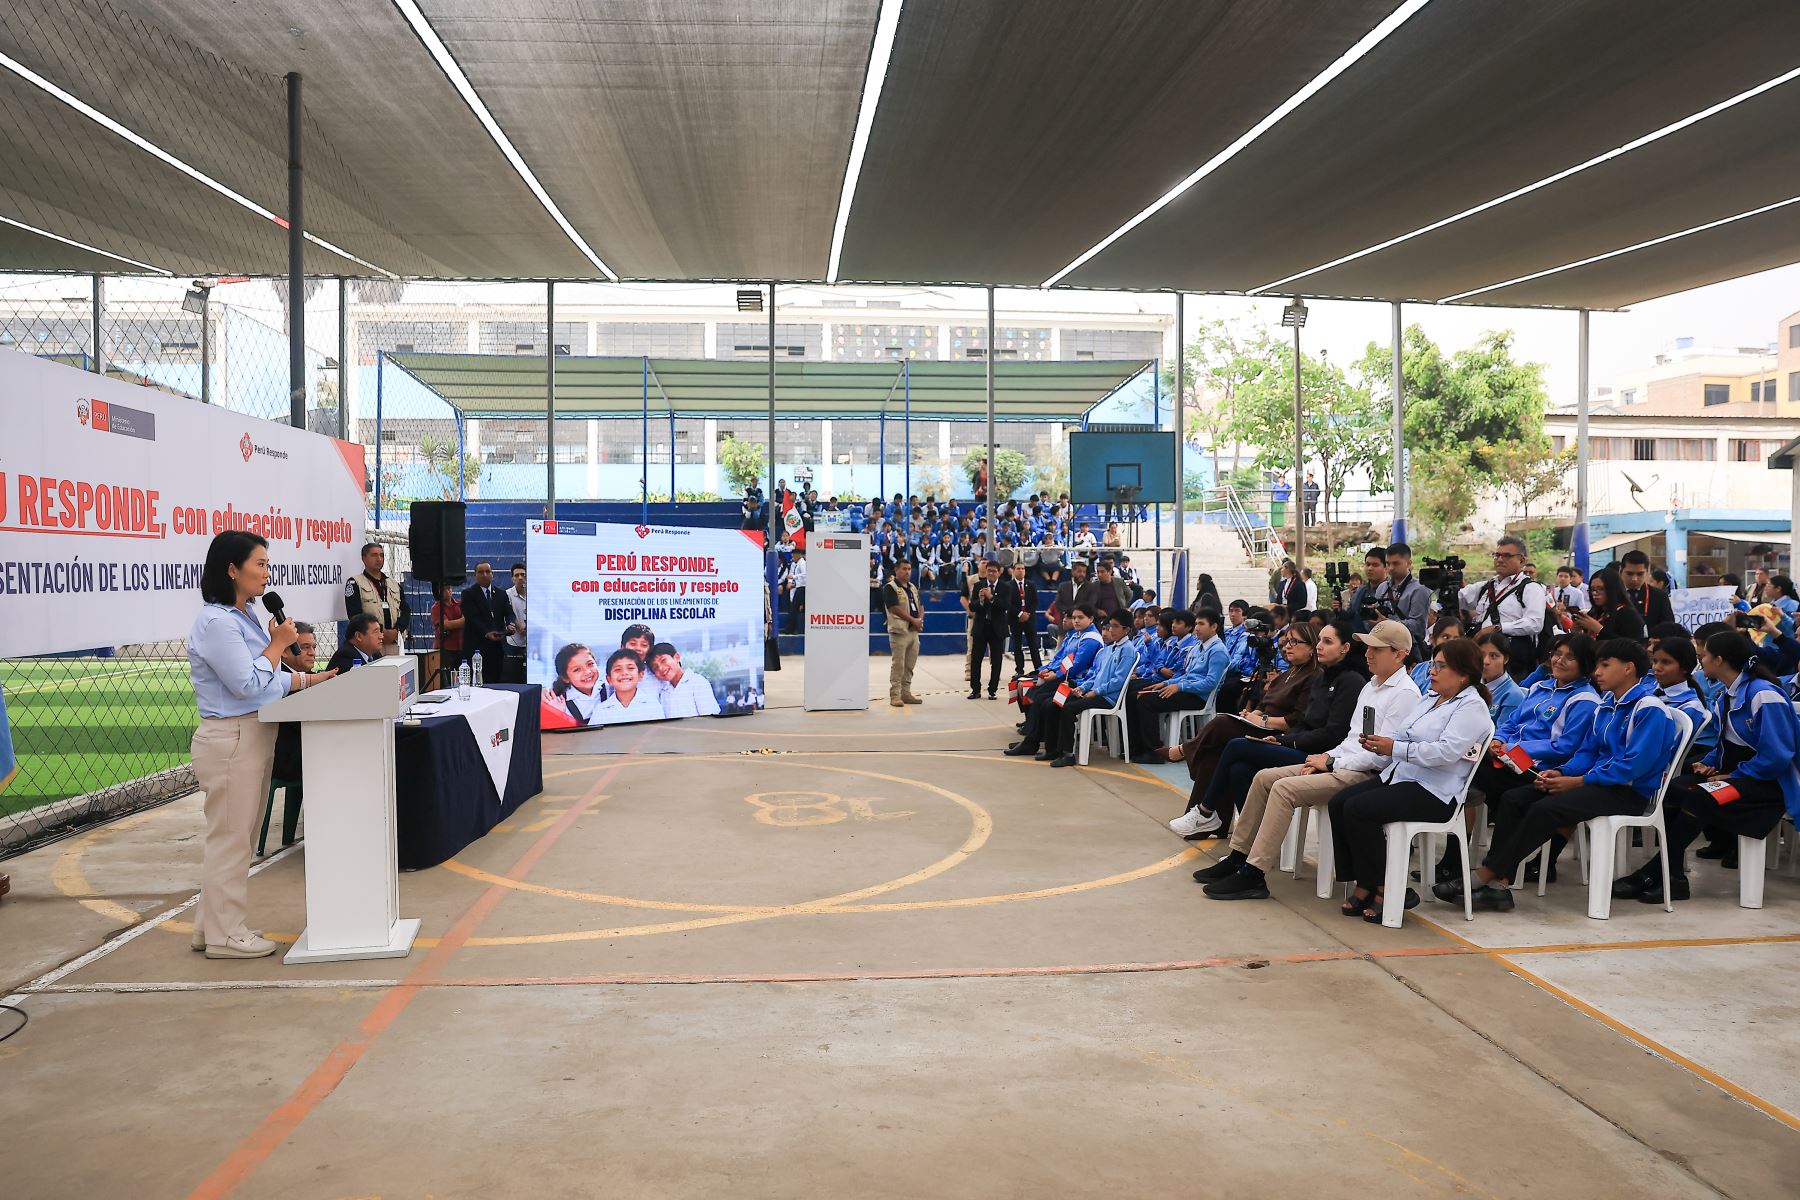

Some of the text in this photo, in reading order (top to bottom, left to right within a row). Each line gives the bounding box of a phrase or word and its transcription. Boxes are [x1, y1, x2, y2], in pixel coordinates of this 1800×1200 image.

[254, 444, 288, 460] Perú Responde
[18, 474, 167, 539] RESPONDE,
[172, 505, 207, 535] con
[212, 502, 292, 540] educación
[295, 516, 303, 549] y
[306, 517, 352, 549] respeto
[596, 551, 719, 574] PERÚ RESPONDE,
[99, 563, 118, 592] DE
[123, 563, 149, 591] LOS
[153, 563, 203, 591] LINEAMI
[267, 564, 306, 587] SCIPLINA
[308, 564, 342, 585] ESCOLAR
[571, 577, 739, 596] con educación y respeto
[598, 597, 645, 606] PRESENTACIÓN
[647, 598, 655, 606] DE
[669, 597, 711, 605] LINEAMIENTOS
[711, 597, 719, 605] DE
[604, 607, 716, 621] DISCIPLINA ESCOLAR
[810, 614, 865, 625] MINEDU
